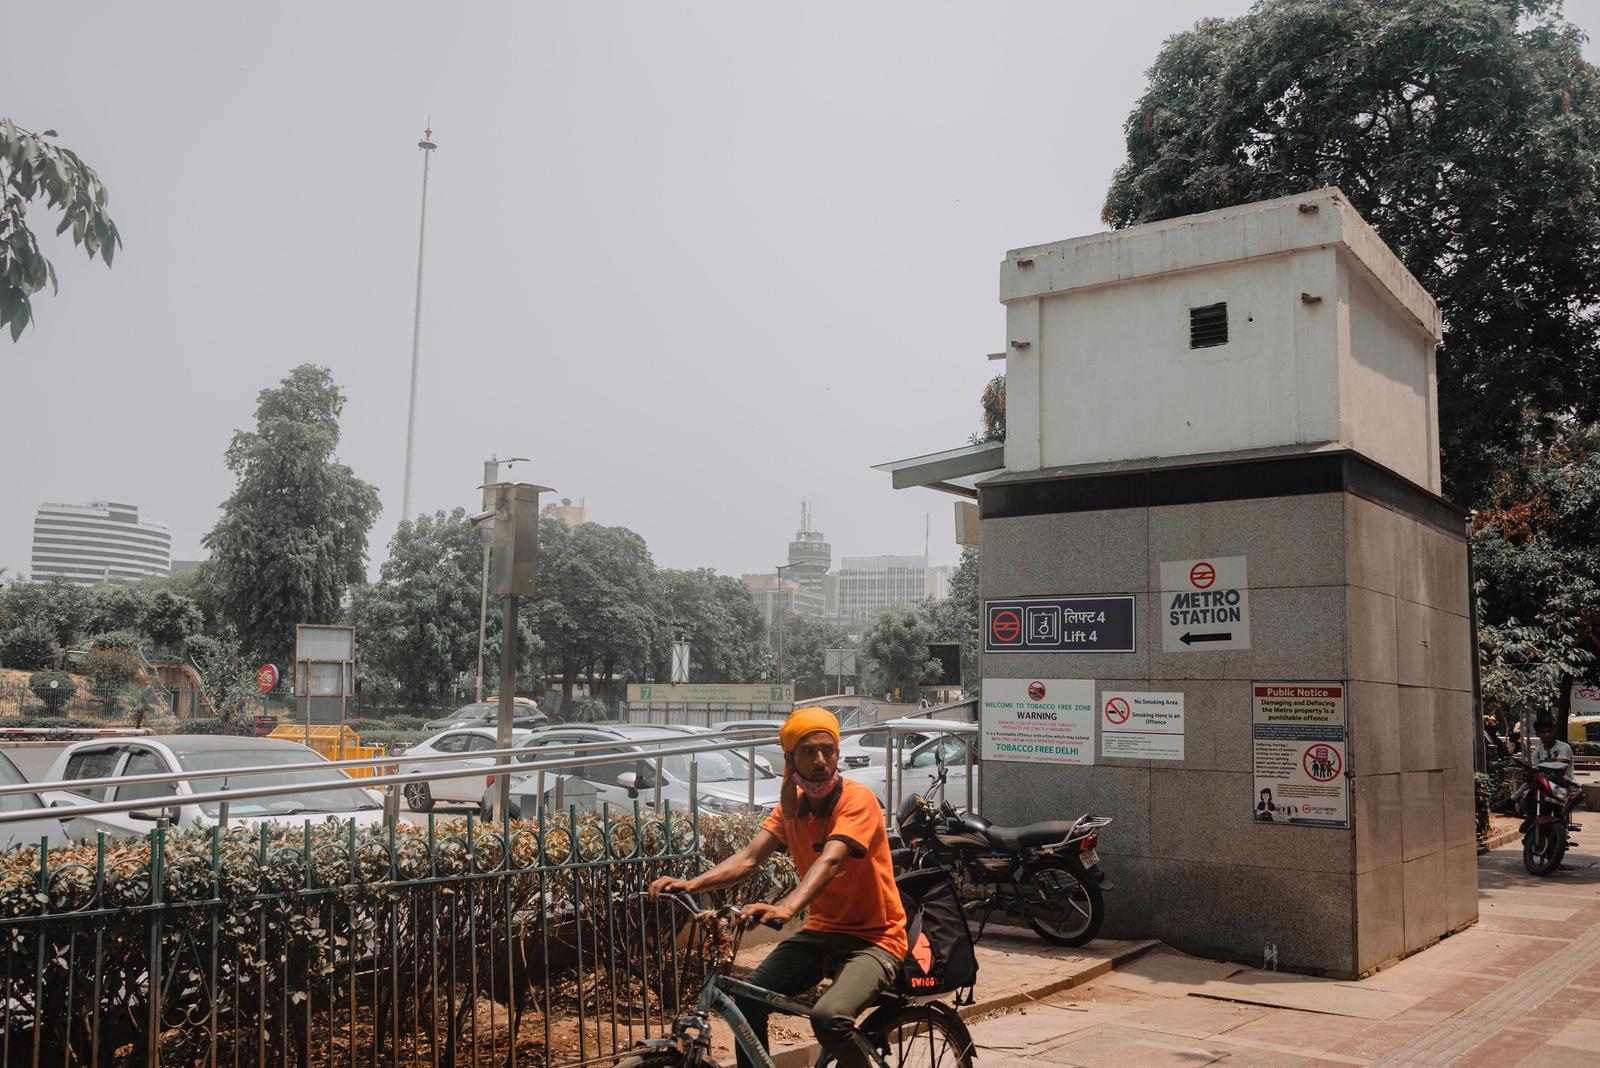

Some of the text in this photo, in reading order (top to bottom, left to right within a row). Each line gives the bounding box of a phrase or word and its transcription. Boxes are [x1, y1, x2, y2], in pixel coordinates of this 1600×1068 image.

[1170, 590, 1240, 609] METRO
[1064, 608, 1106, 624] लिफ्ट 4
[1170, 607, 1240, 626] STATION
[1064, 631, 1098, 642] Lift 4
[773, 689, 780, 699] 7
[1017, 711, 1057, 720] WARNING
[996, 744, 1033, 752] TOBACCO
[911, 976, 938, 988] SWIGG
